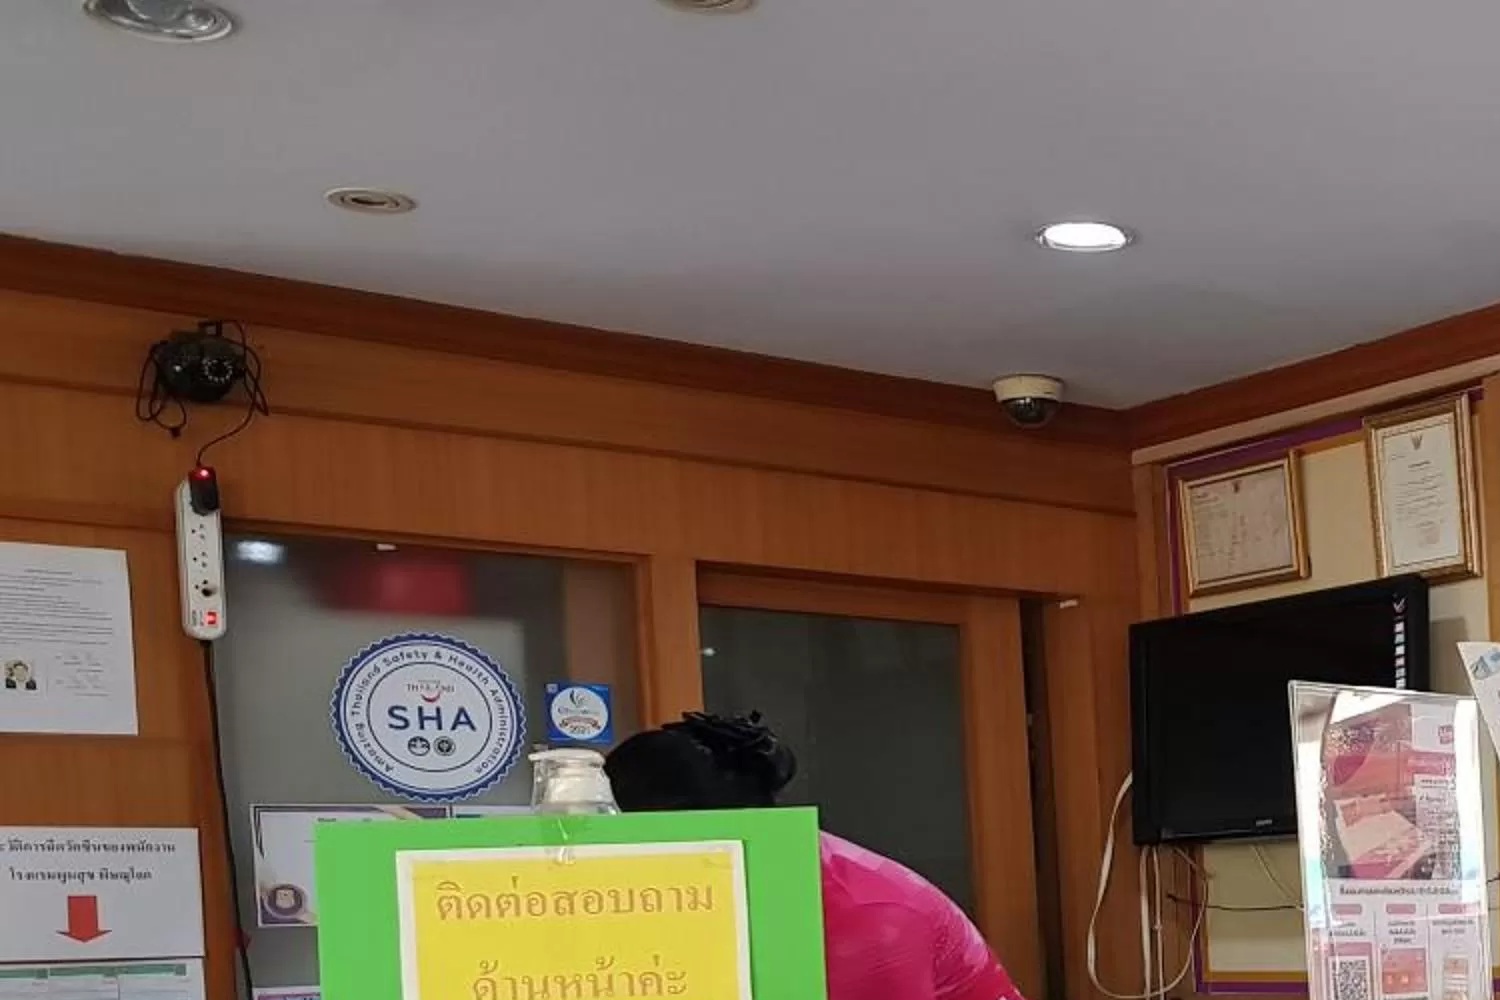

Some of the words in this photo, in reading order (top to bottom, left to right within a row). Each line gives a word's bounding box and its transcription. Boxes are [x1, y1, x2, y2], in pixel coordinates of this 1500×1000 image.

[387, 705, 477, 733] SHA
[436, 876, 714, 923] ติดต่อสอบถาม
